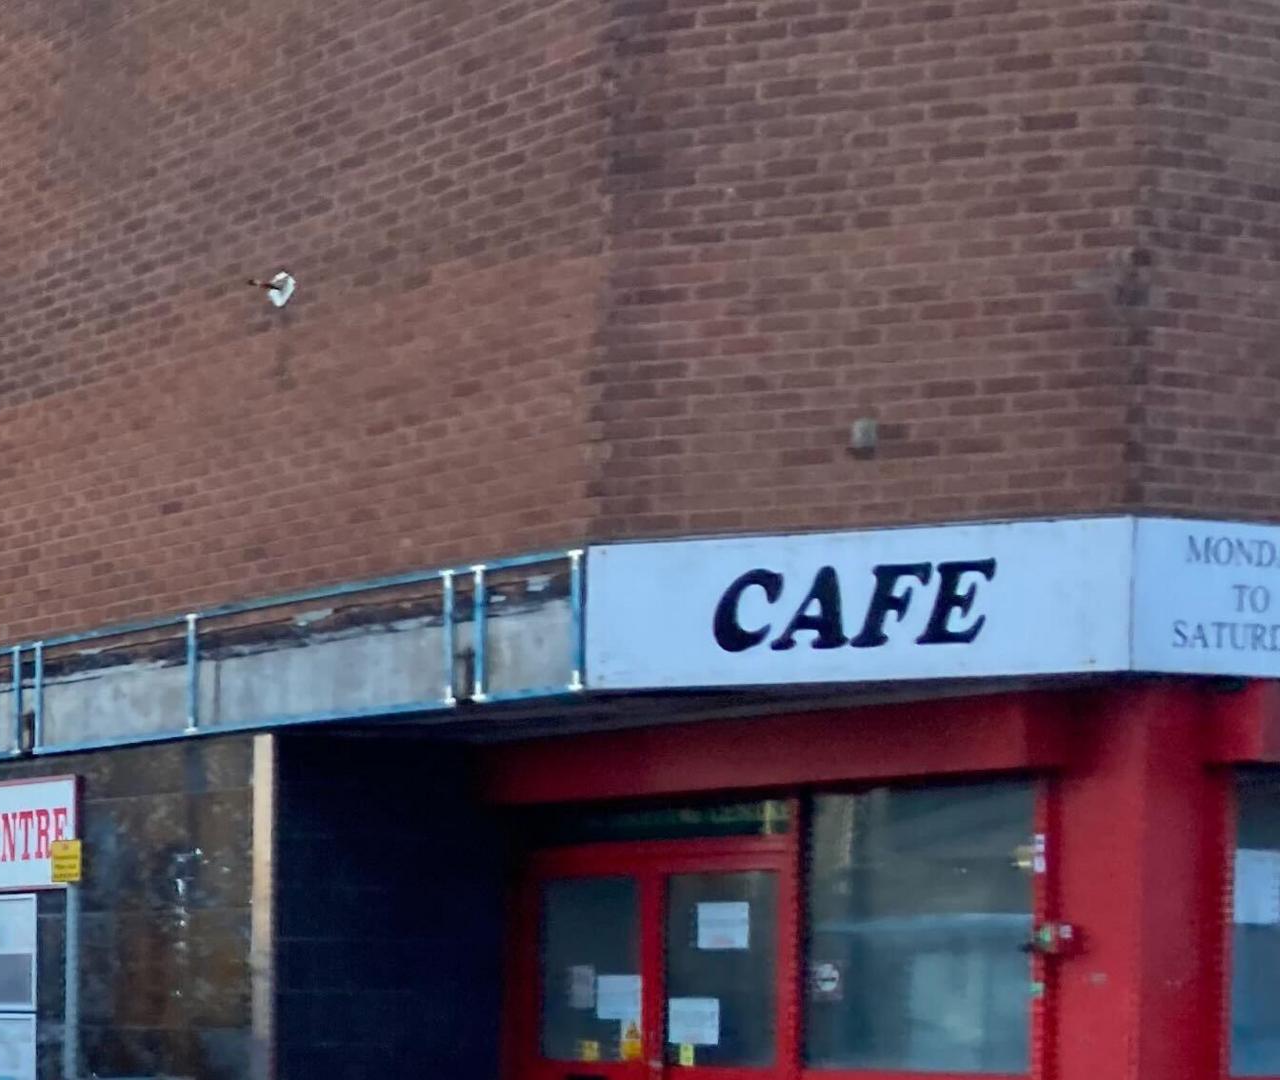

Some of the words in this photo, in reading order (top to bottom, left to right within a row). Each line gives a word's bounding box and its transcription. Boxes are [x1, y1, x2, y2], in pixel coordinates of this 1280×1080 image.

[1185, 535, 1280, 568] MOND
[712, 557, 997, 653] CAFE
[1231, 584, 1271, 614] TO
